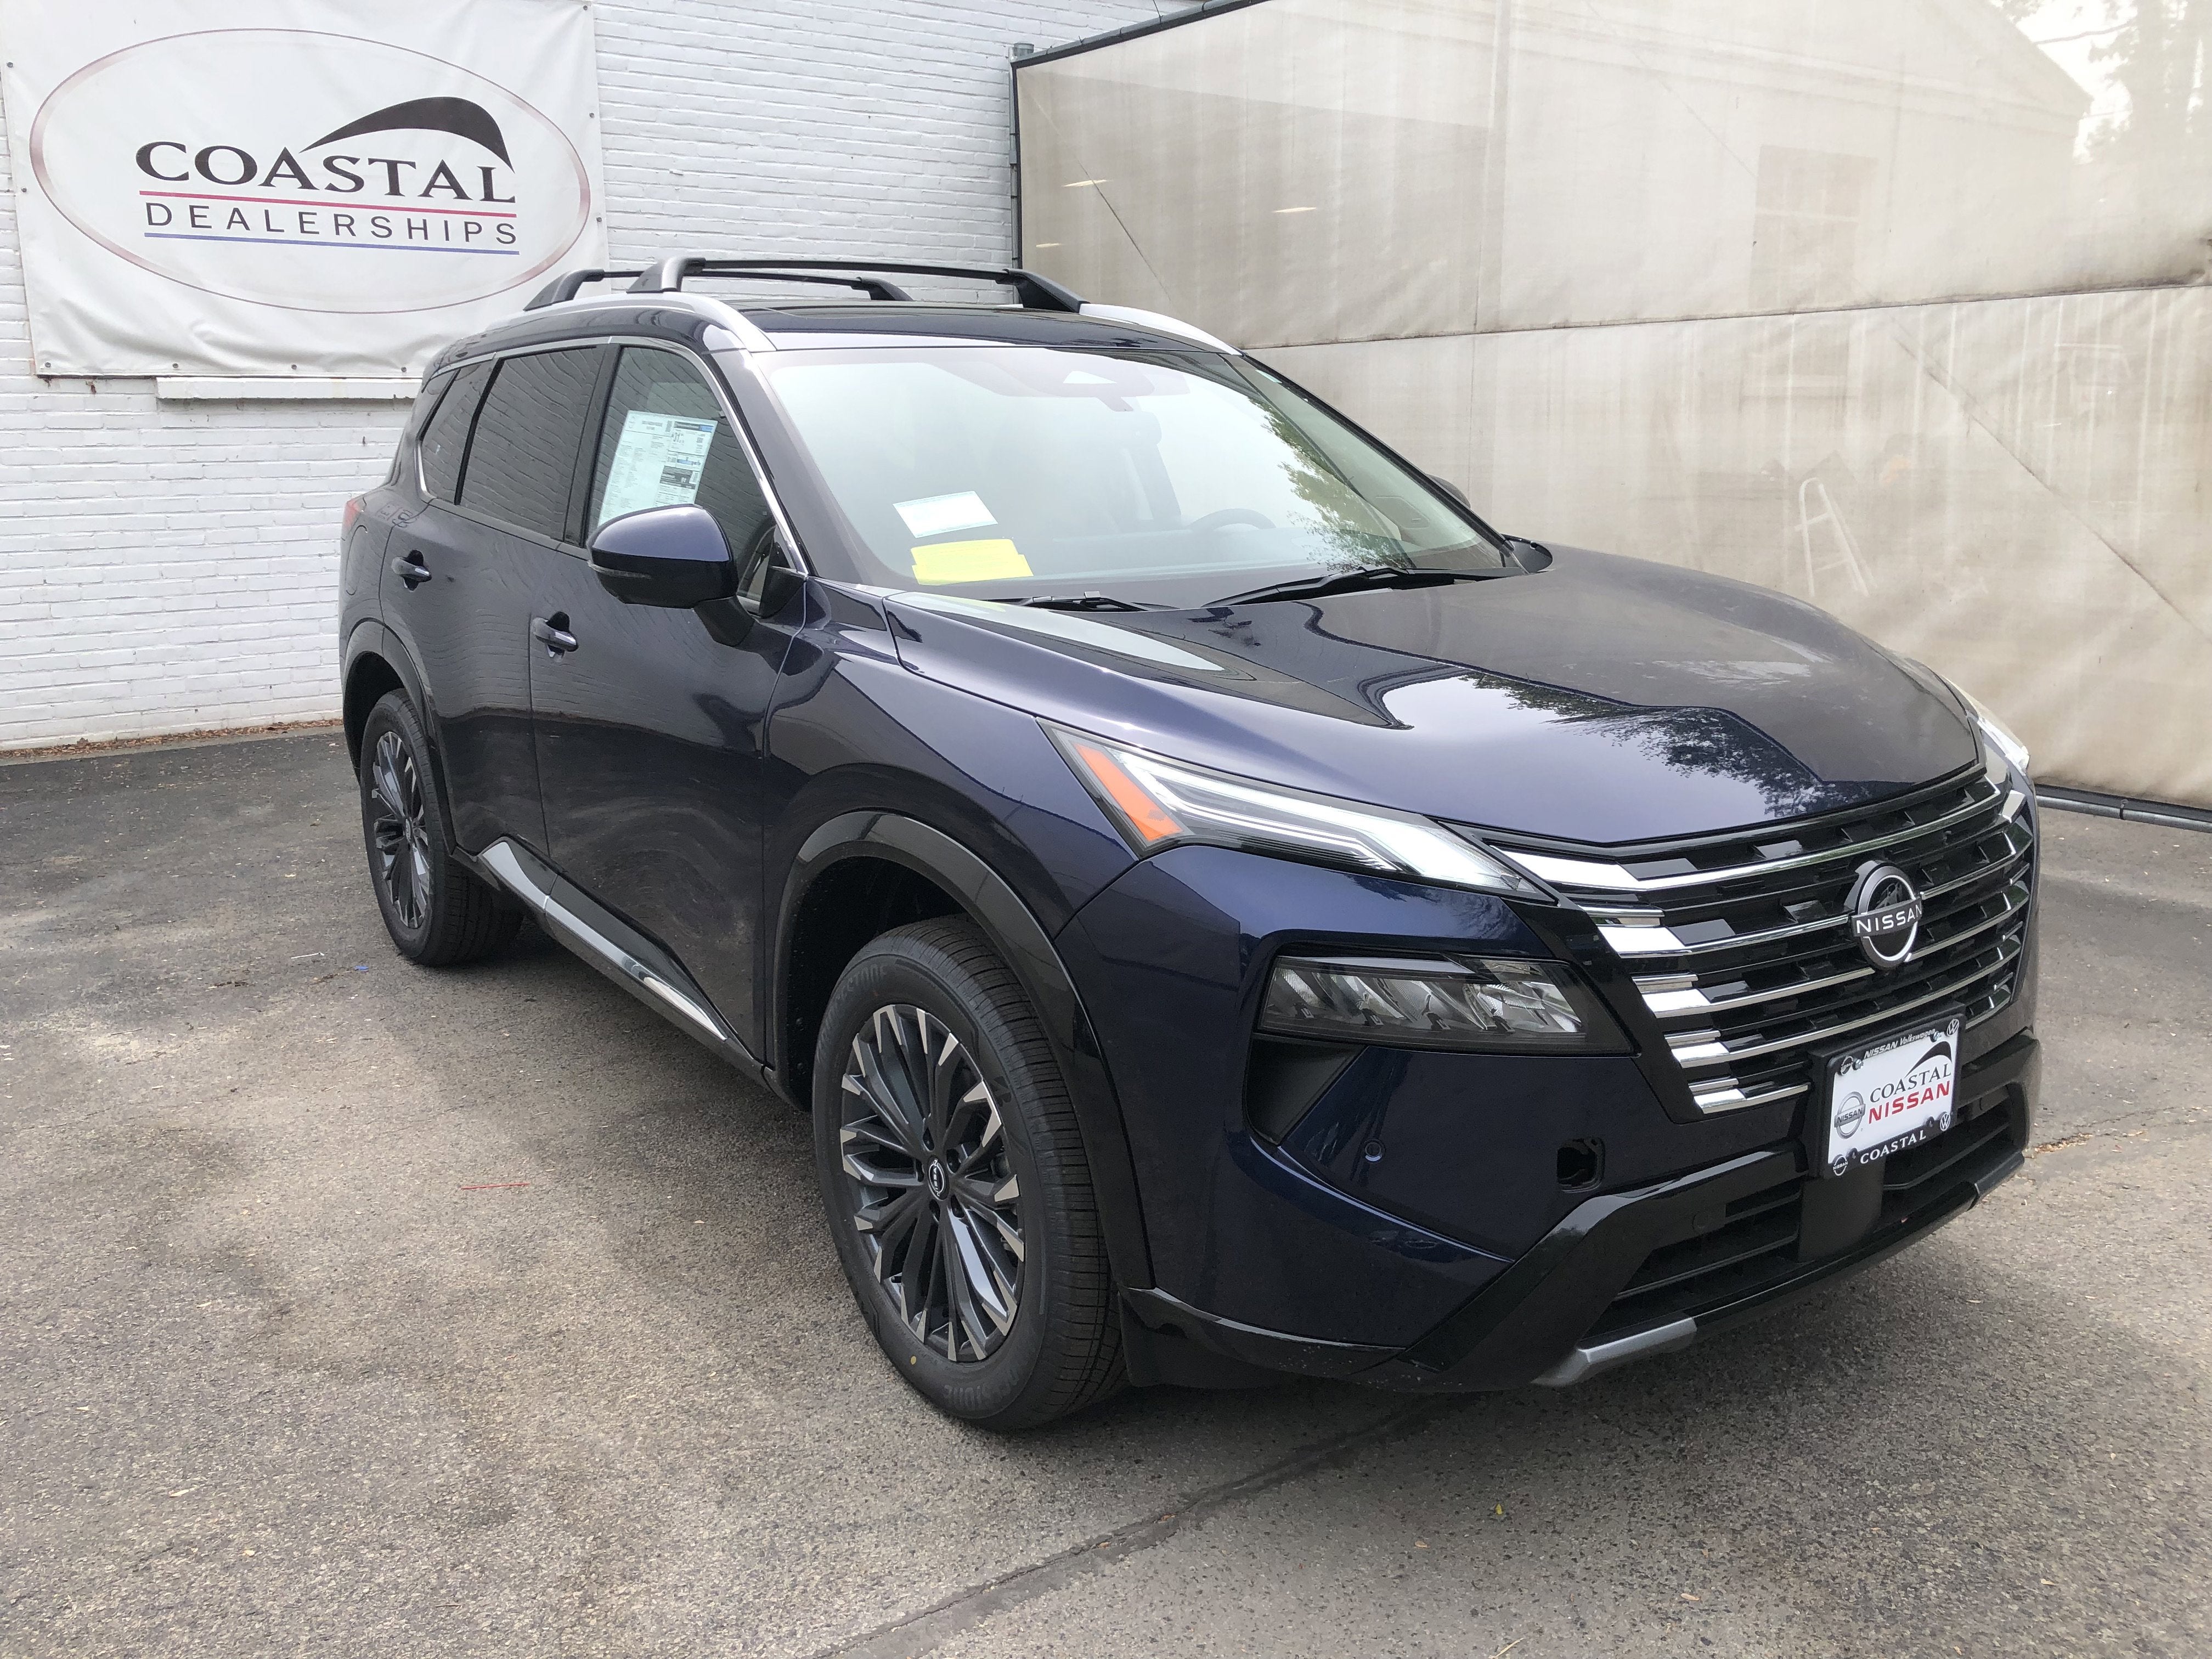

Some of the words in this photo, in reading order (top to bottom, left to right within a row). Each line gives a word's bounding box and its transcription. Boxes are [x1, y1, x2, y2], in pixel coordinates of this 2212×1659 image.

[135, 141, 516, 204] COASTAL
[145, 202, 517, 245] DEALERSHIPS
[1856, 904, 1922, 934] NISSAN
[1863, 1040, 1898, 1059] NISSAN
[1899, 1028, 1936, 1045] Volkswagen
[1870, 1063, 1951, 1103] COASTAL
[1837, 1107, 1863, 1123] NISSAN
[1868, 1080, 1950, 1124] NISSAN
[1860, 1130, 1927, 1164] COASTAL
[1832, 1161, 1848, 1171] NISSAN
